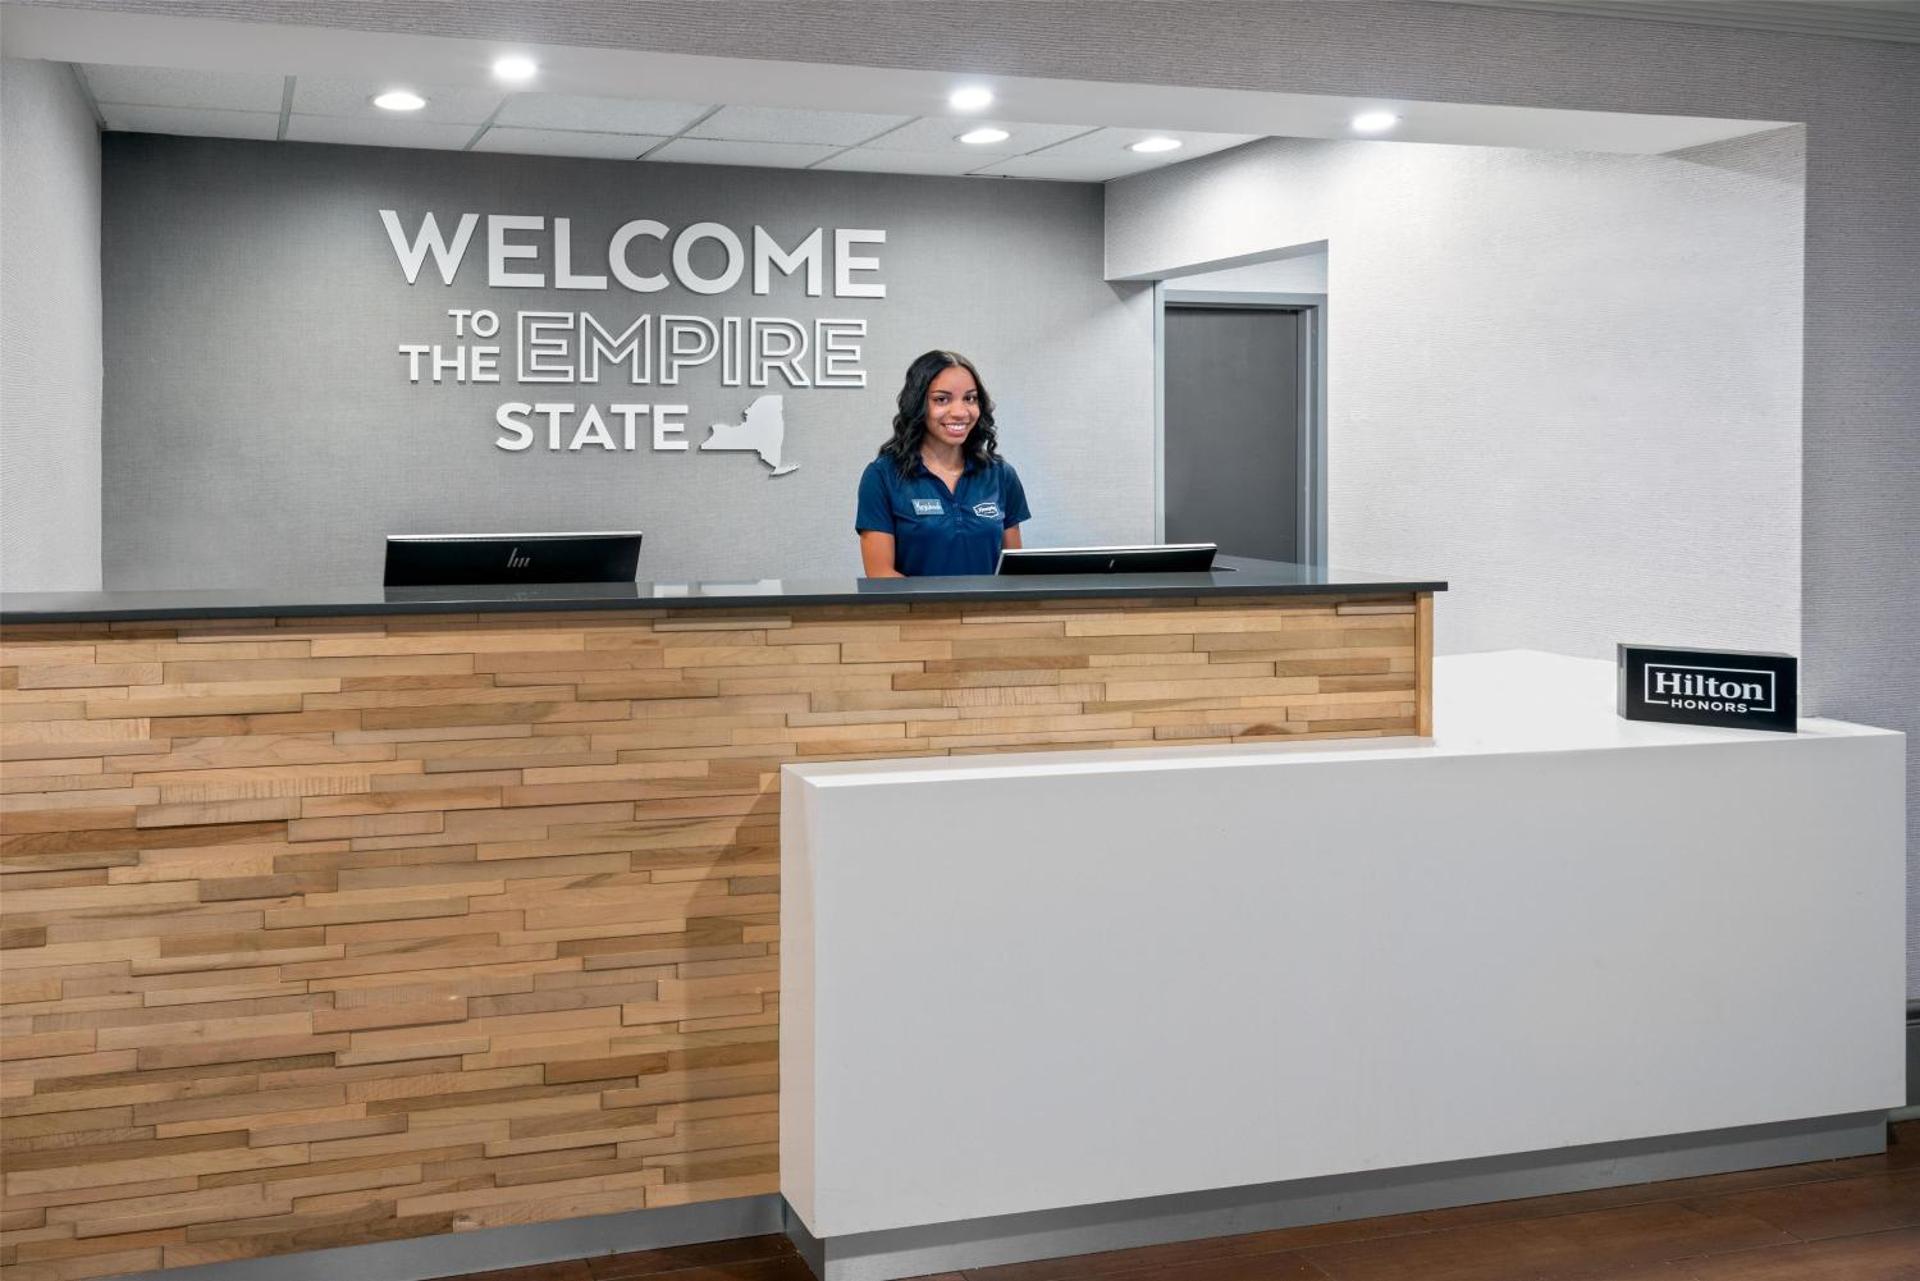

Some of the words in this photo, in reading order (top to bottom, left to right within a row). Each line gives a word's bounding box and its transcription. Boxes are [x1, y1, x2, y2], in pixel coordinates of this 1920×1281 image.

[379, 210, 887, 298] WELCOME
[448, 308, 500, 338] TO
[399, 344, 500, 384] THE
[516, 311, 868, 389] EMPIRE
[495, 402, 690, 451] STATE
[1655, 673, 1764, 701] Hilton
[1671, 698, 1748, 713] HONORS
